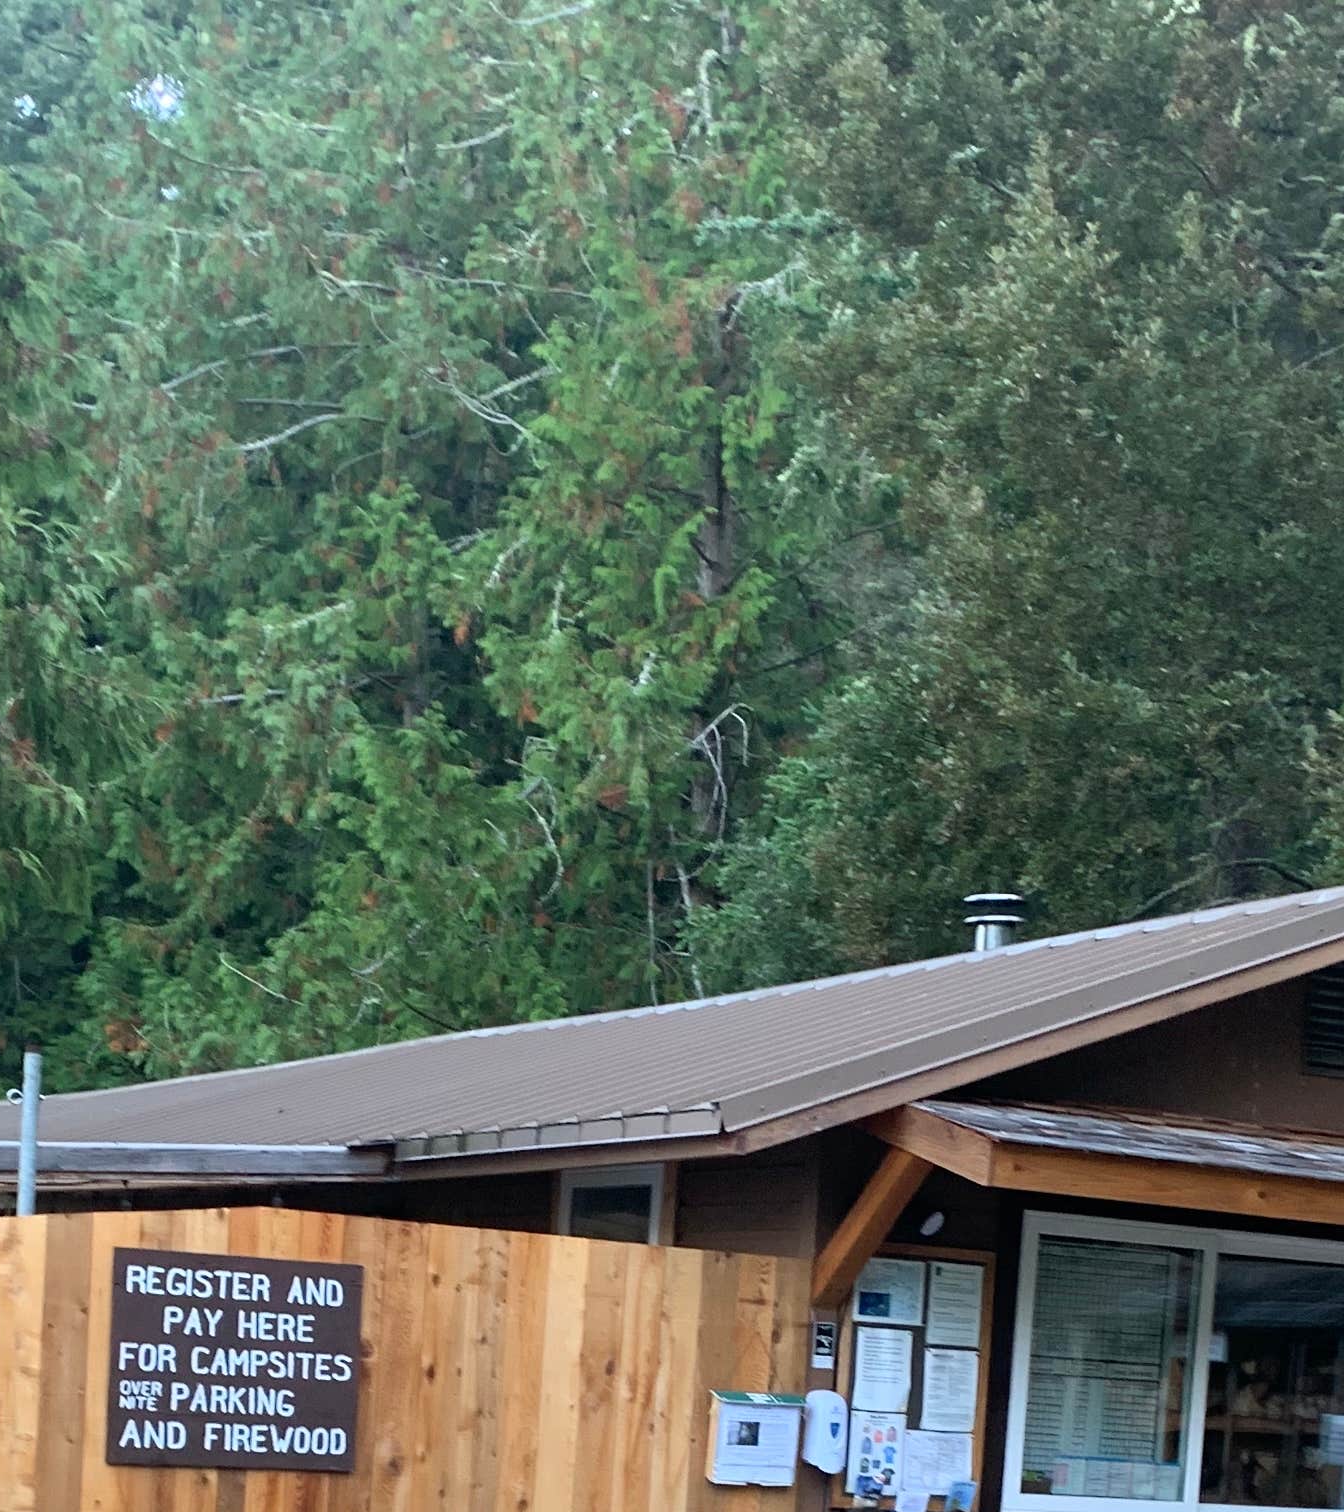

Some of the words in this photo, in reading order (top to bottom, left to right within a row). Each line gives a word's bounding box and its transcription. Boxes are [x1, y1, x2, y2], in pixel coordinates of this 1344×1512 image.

[126, 1265, 270, 1301] REGISTER
[287, 1276, 344, 1307] AND
[162, 1306, 223, 1337] PAY
[237, 1310, 315, 1342] HERE
[118, 1342, 177, 1372] FOR
[190, 1347, 352, 1381] CAMPSITES
[119, 1380, 162, 1396] OVER
[119, 1396, 158, 1412] NITE
[170, 1382, 295, 1417] PARKING
[119, 1420, 186, 1449] AND
[204, 1423, 347, 1455] FIREWOOD
